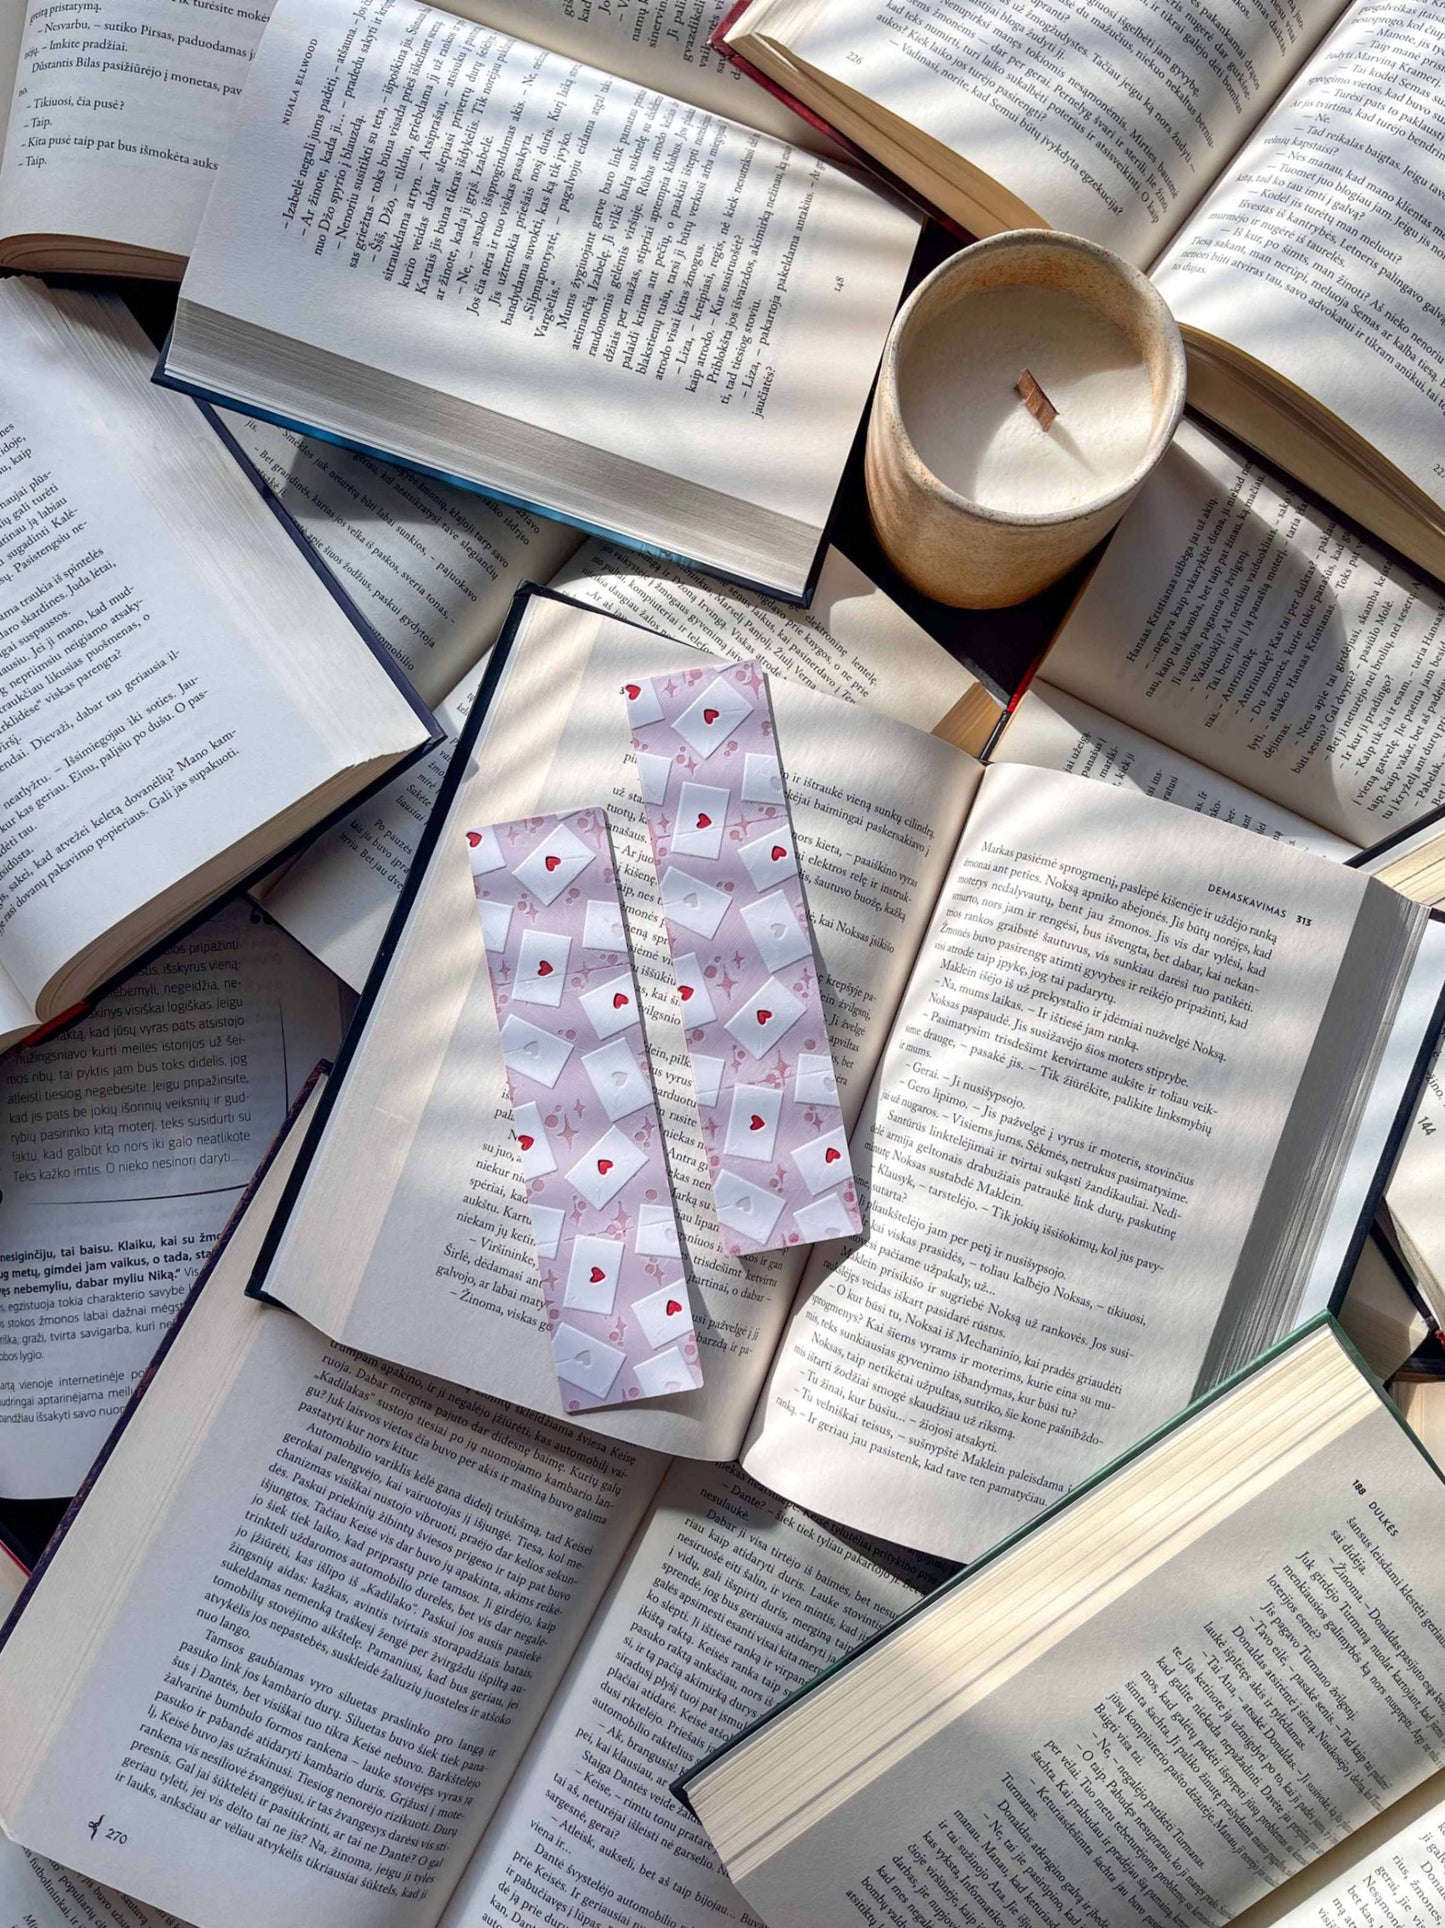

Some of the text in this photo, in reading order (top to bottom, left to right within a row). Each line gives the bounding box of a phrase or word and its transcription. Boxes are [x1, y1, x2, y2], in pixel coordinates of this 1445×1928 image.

[44, 18, 246, 57] Nesvarbu, sutiko Pirsas, paduodamas
[49, 38, 128, 52] Imkite pradžiai.
[845, 51, 863, 65] 226
[33, 96, 125, 111] Tikiuosi, čia pusė?
[281, 38, 318, 125] NUALA ELLWOOD
[27, 136, 47, 148] Kita
[47, 137, 71, 148] pusė
[73, 135, 95, 150] taip
[96, 139, 115, 151] pat
[117, 138, 137, 152] bus
[139, 144, 190, 164] išmokėta
[31, 116, 52, 130] Taip.
[282, 77, 340, 220] Izabelė negali jums padėti,
[940, 69, 969, 92] norite,
[970, 84, 991, 102] kad
[991, 97, 1020, 123] Semui
[1019, 117, 1041, 141] būtų
[1039, 136, 1079, 171] įvykdyta
[1079, 169, 1123, 214] egzekucija?
[25, 155, 47, 168] Taip.
[1306, 125, 1428, 186] Tad reikalas baigtas. Jeigu
[314, 115, 366, 256] nuo Džo spyrio į blauzdą.
[1286, 198, 1303, 212] jis
[1335, 219, 1359, 237] man
[1359, 233, 1402, 262] meluoti?
[741, 191, 815, 389] Liza, pakartoja pakeldama antakius.
[834, 275, 844, 292] 148
[751, 366, 775, 419] jaučiatės?
[400, 571, 426, 596] sveria
[628, 579, 687, 633] kompiuteriai ir
[1125, 628, 1152, 662] Hansas
[1146, 578, 1178, 627] Kristianas
[1188, 531, 1201, 546] jai
[1195, 519, 1206, 531] už
[371, 589, 435, 648] paskui gydytoja
[1340, 674, 1394, 761] Ir kur ji pradingo?
[55, 730, 236, 853] atvežei keletą dovanėlių? Mano kam-
[95, 747, 239, 849] popieriaus. Gali jas supakuoti.
[807, 854, 847, 876] elektros
[849, 871, 868, 887] relę
[869, 877, 879, 889] ir
[1207, 883, 1312, 926] DEMASKAVIMAS 313
[939, 958, 977, 977] Maklein
[1004, 978, 1014, 989] iš
[1016, 983, 1030, 994] už
[1030, 988, 1090, 1014] prekystalio
[1091, 1006, 1102, 1018] ir
[1101, 1009, 1143, 1032] įdėmiai
[1144, 1027, 1190, 1049] nužvelgė
[1191, 1039, 1226, 1063] Noksą.
[1417, 1116, 1437, 1136] 144
[0, 1235, 195, 1264] nesiginčiju, tai baisu. Klaiku, kai su
[13, 1280, 72, 1294] nebemyliu,
[75, 1277, 109, 1289] dabar
[112, 1272, 144, 1286] myliu
[435, 1265, 518, 1299] galvojo, ar labai
[807, 1369, 818, 1385] Tu
[819, 1378, 845, 1400] žinai,
[847, 1389, 866, 1406] kur
[918, 1418, 954, 1438] žiojosi
[954, 1433, 997, 1453] atsakyti.
[305, 1422, 372, 1458] Automobilio
[374, 1454, 412, 1477] variklis
[412, 1469, 435, 1487] kėlė
[434, 1483, 461, 1500] gana
[463, 1493, 492, 1516] didelį
[494, 1508, 542, 1537] triukšmą,
[545, 1530, 563, 1544] tad
[1352, 1479, 1399, 1537] 188 DULKĖS
[705, 1508, 871, 1607] Dabar ji visa tirtėjo iš baimės, bet
[1266, 1573, 1322, 1640] loterijos esmė?
[1259, 1601, 1358, 1721] Jis pagavo Turmano žvilgsnį.
[1093, 1702, 1145, 1768] Baigti visa tai.
[105, 1827, 128, 1845] 270
[114, 1772, 126, 1782] ir
[126, 1774, 157, 1799] lauks,
[159, 1793, 207, 1820] anksčiau
[208, 1815, 222, 1826] ar
[224, 1821, 255, 1842] vėliau
[256, 1837, 303, 1863] atvykėlis
[305, 1857, 358, 1885] tikriausiai
[545, 1789, 620, 1840] sargesnė, gerai?
